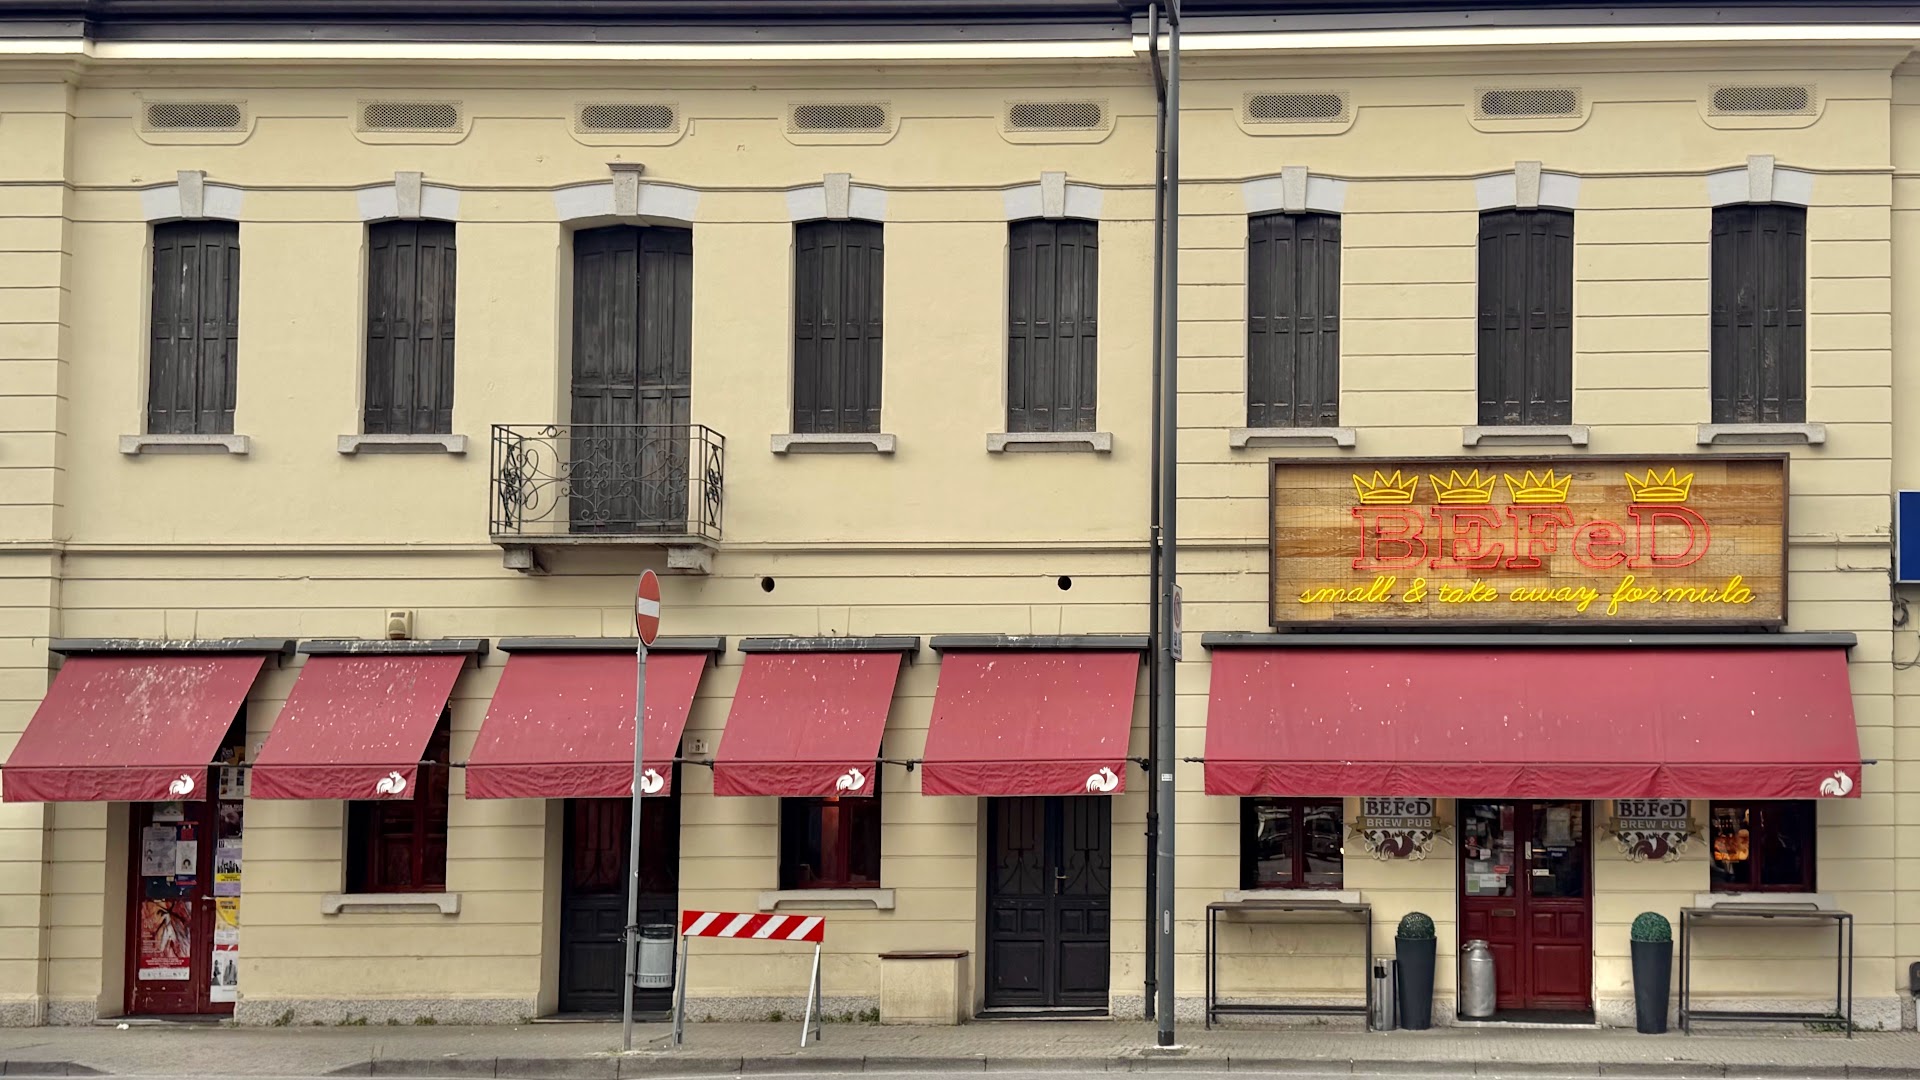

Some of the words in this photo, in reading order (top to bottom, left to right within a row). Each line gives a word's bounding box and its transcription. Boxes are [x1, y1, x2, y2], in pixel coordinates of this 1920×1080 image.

[1351, 504, 1712, 570] BEFeD
[1298, 575, 1397, 603] small
[1402, 577, 1428, 603] &
[1438, 577, 1499, 603] take
[1509, 585, 1600, 612] away
[1606, 574, 1757, 616] formula
[1365, 801, 1431, 816] BEFeD
[1618, 802, 1686, 817] BEFeD
[1366, 818, 1402, 827] BREW
[1407, 818, 1432, 827] PUB
[1620, 820, 1656, 829] BREW
[1661, 820, 1687, 829] PUB
